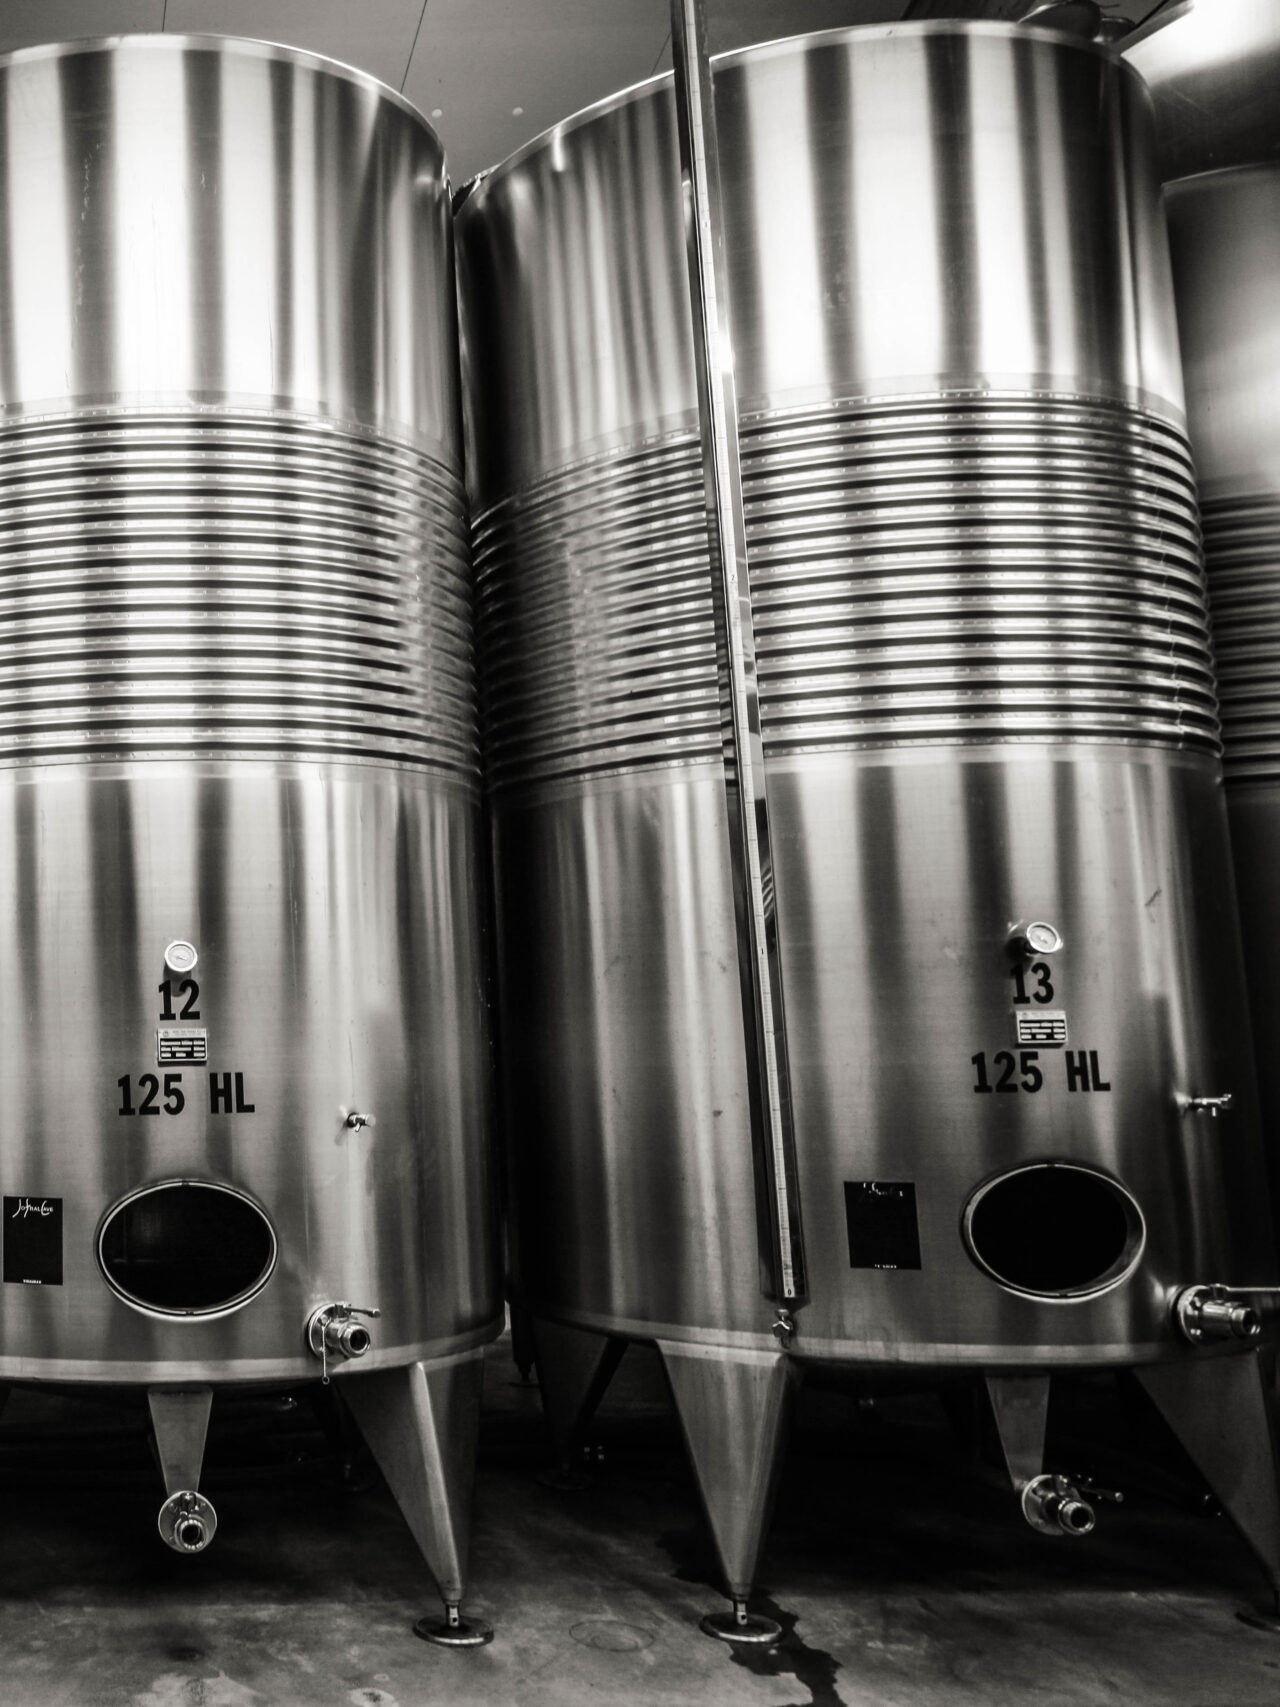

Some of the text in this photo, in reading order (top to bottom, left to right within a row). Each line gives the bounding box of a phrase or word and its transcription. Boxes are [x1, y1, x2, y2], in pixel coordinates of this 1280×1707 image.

[158, 979, 201, 1021] 12
[1010, 962, 1055, 1004] 13
[971, 1050, 1111, 1093] 125 HL
[117, 1072, 256, 1116] 125 HL
